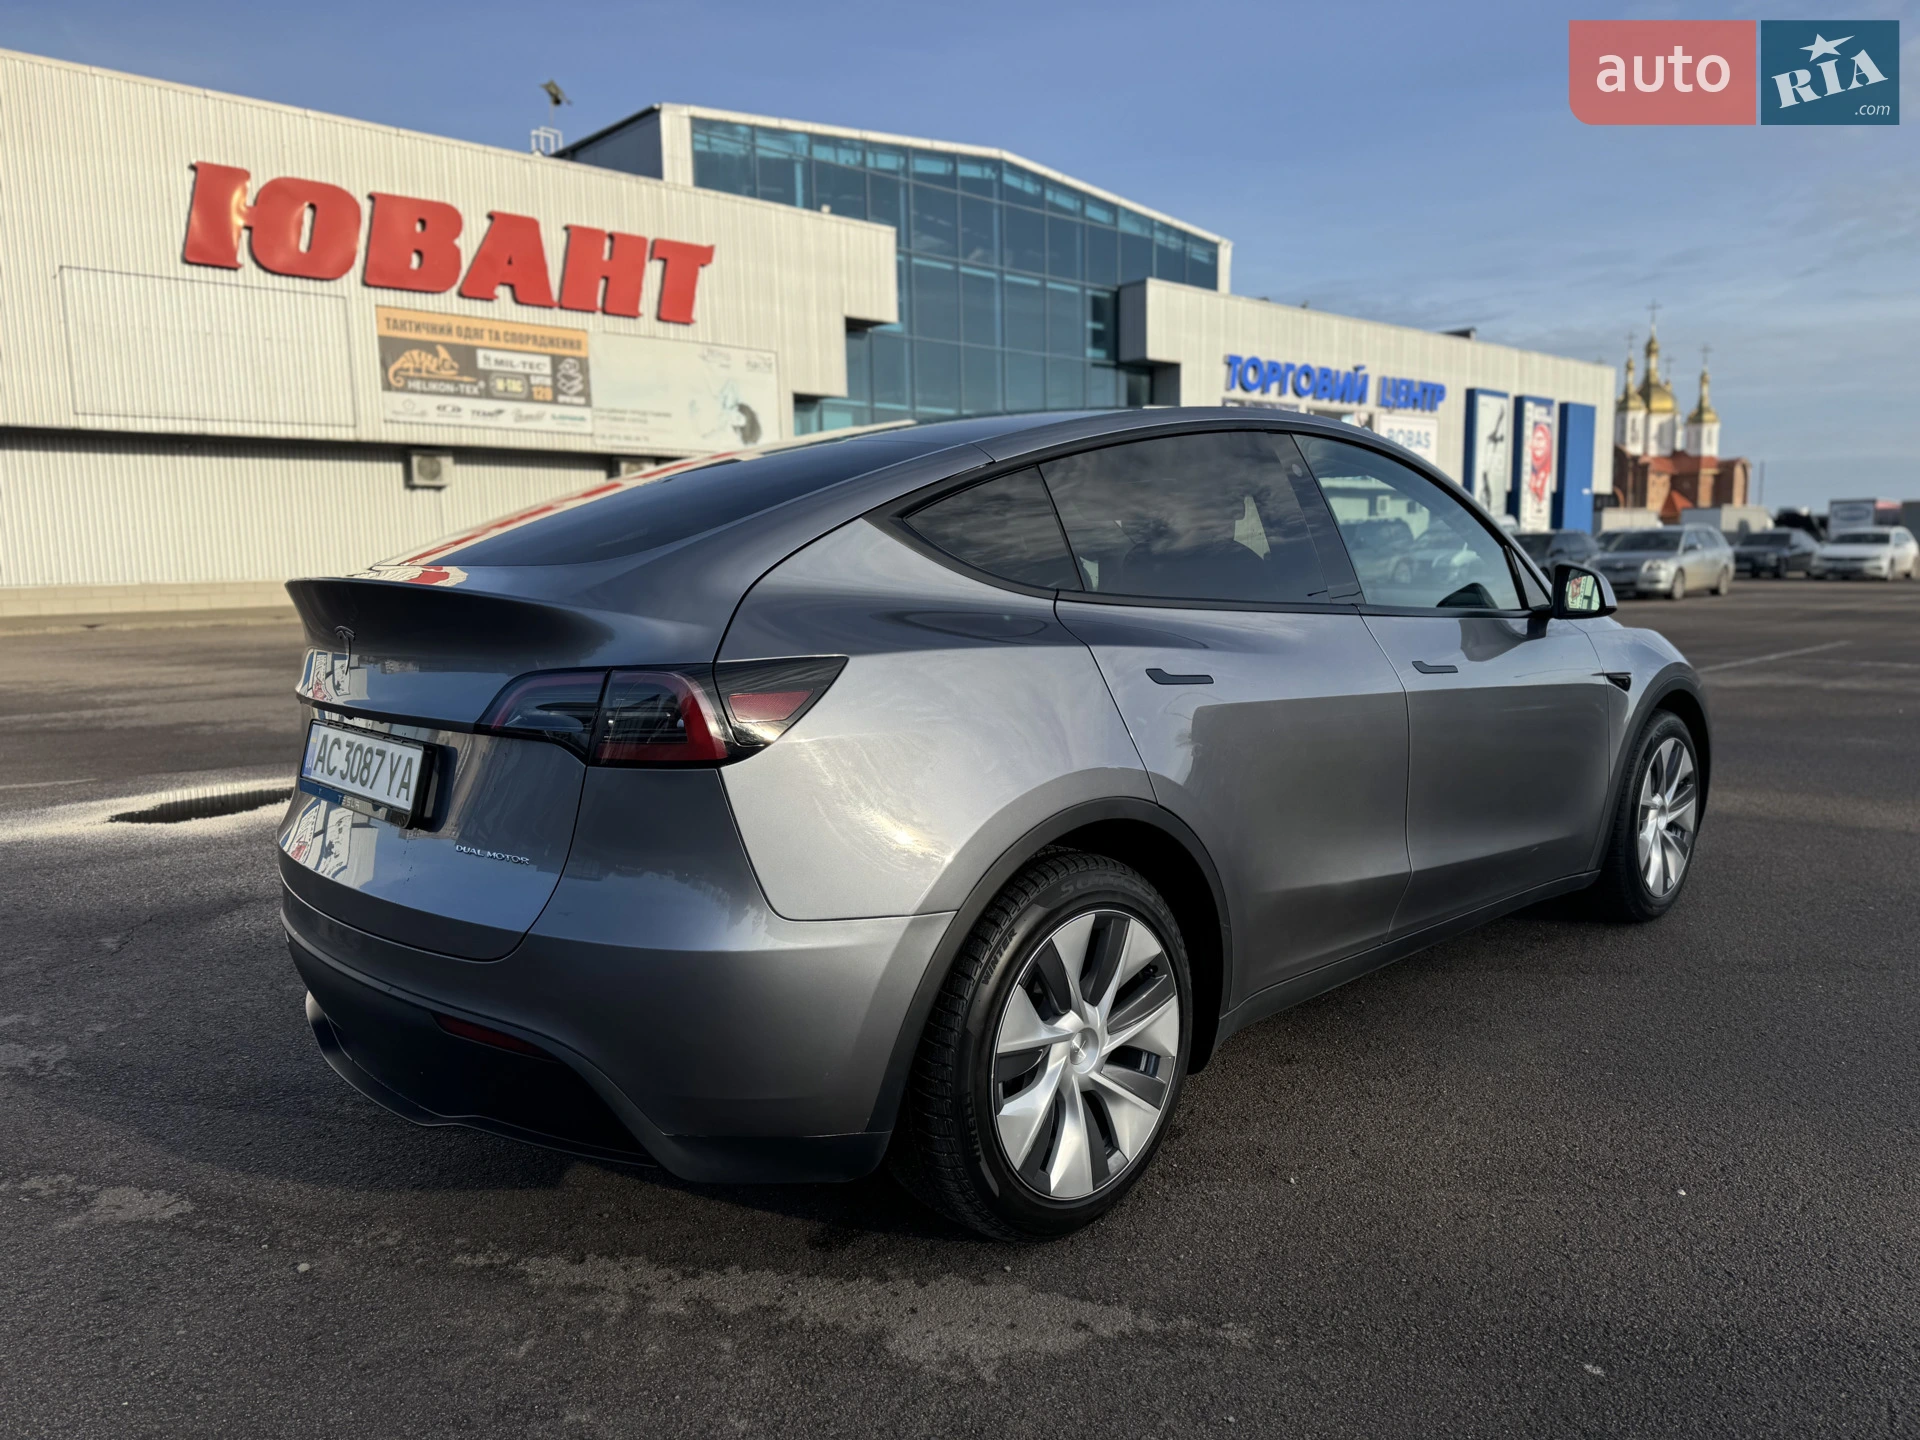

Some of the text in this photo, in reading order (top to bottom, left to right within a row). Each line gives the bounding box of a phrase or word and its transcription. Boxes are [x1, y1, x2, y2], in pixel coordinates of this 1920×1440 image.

[182, 160, 716, 325] ЮВАНТ
[385, 317, 453, 336] ТАКТИЧНИЙ
[456, 326, 485, 341] ОДЯГ
[488, 329, 501, 342] ТА
[1224, 353, 1446, 412] ТОРГОВИЙ ЦЕНТР
[314, 734, 414, 802] AC 3087 YA
[455, 844, 531, 866] DUAL MOTOR
[981, 928, 1017, 985] WINTER
